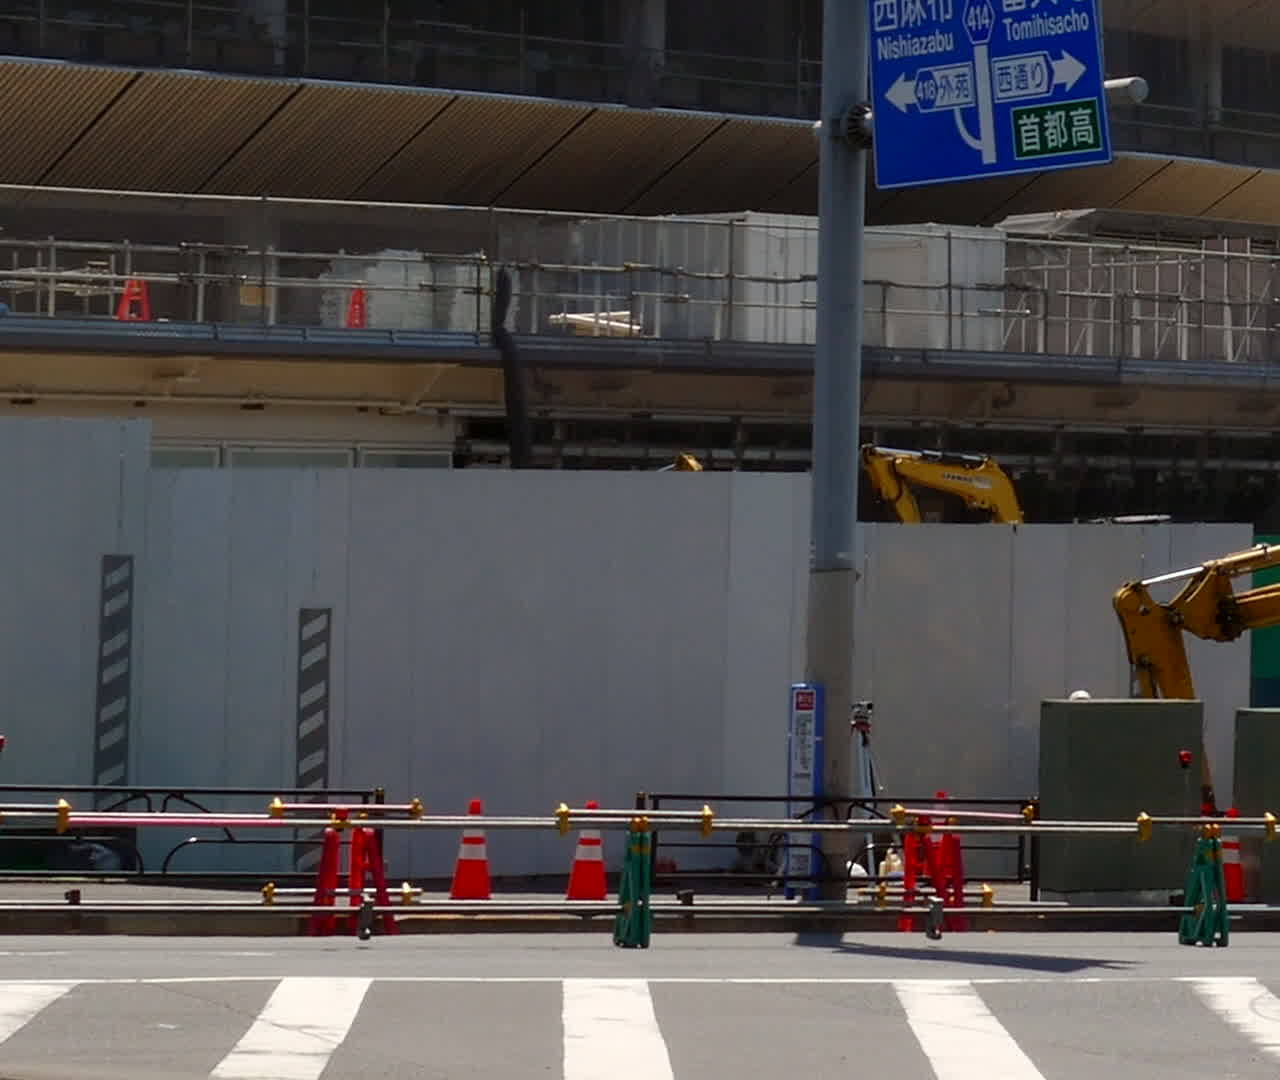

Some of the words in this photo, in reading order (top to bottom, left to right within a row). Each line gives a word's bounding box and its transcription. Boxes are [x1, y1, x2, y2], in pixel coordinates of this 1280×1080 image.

[967, 4, 990, 32] 414
[1002, 8, 1089, 41] Tomihisacho
[877, 29, 954, 61] Nishiazabu
[917, 80, 935, 101] 418
[997, 62, 1045, 93] 西通り
[1018, 107, 1095, 152] 首都高
